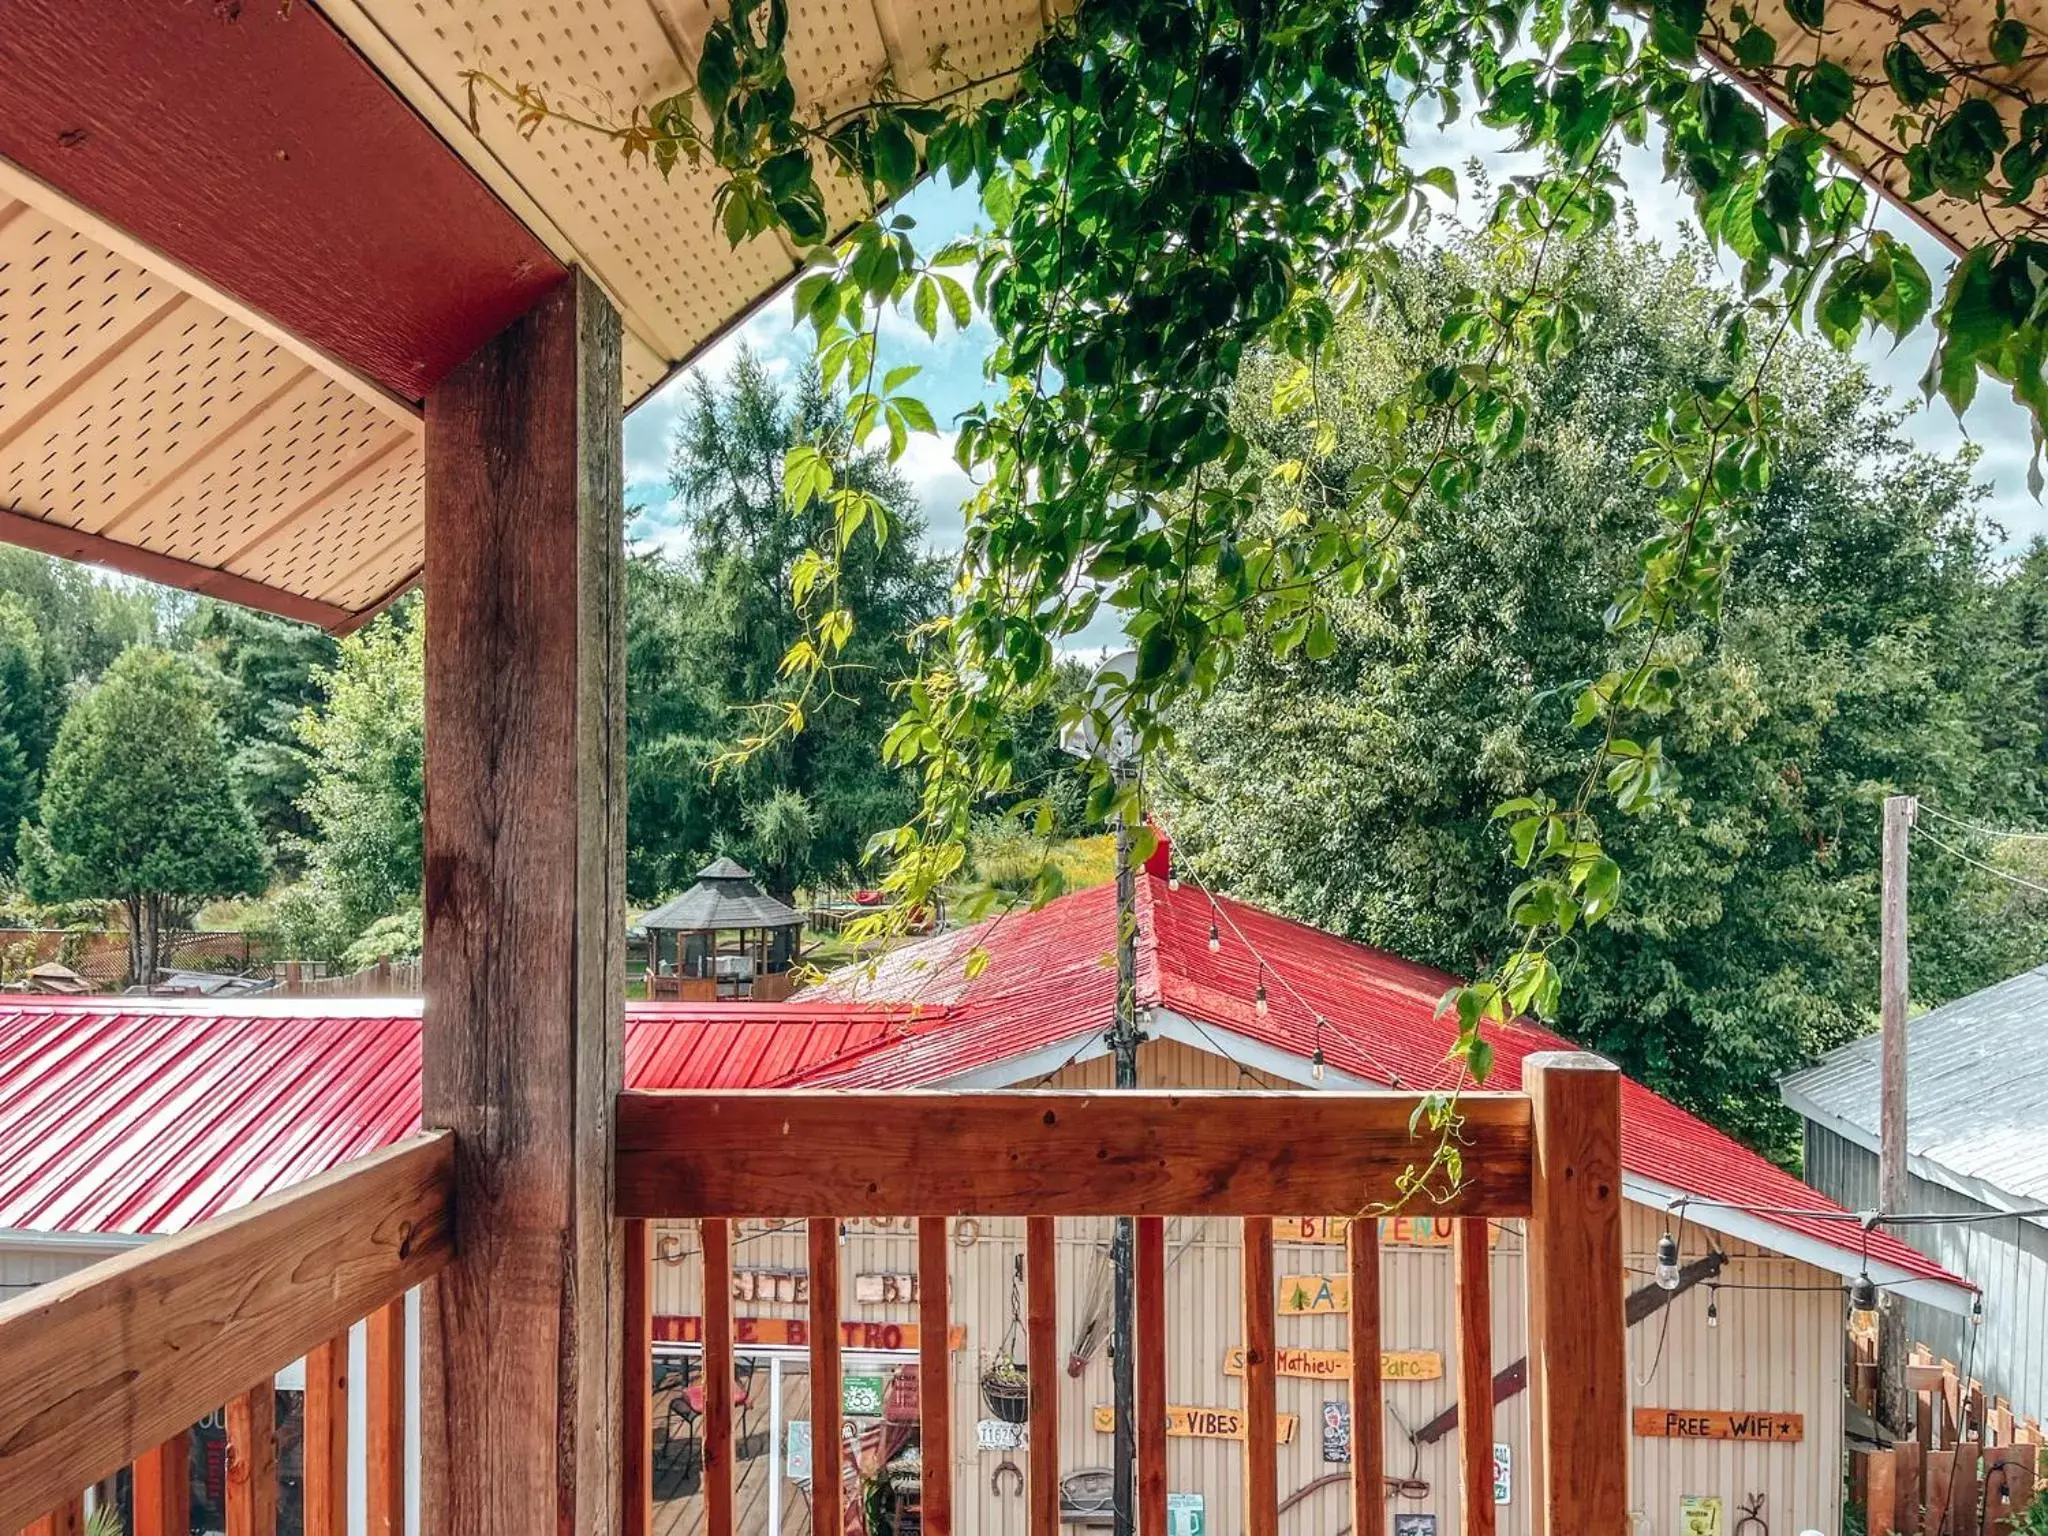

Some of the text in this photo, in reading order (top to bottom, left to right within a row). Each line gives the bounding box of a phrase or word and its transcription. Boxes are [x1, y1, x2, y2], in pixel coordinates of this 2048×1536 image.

[1187, 1411, 1239, 1434] VIBES
[1665, 1413, 1773, 1437] FREE WiFi
